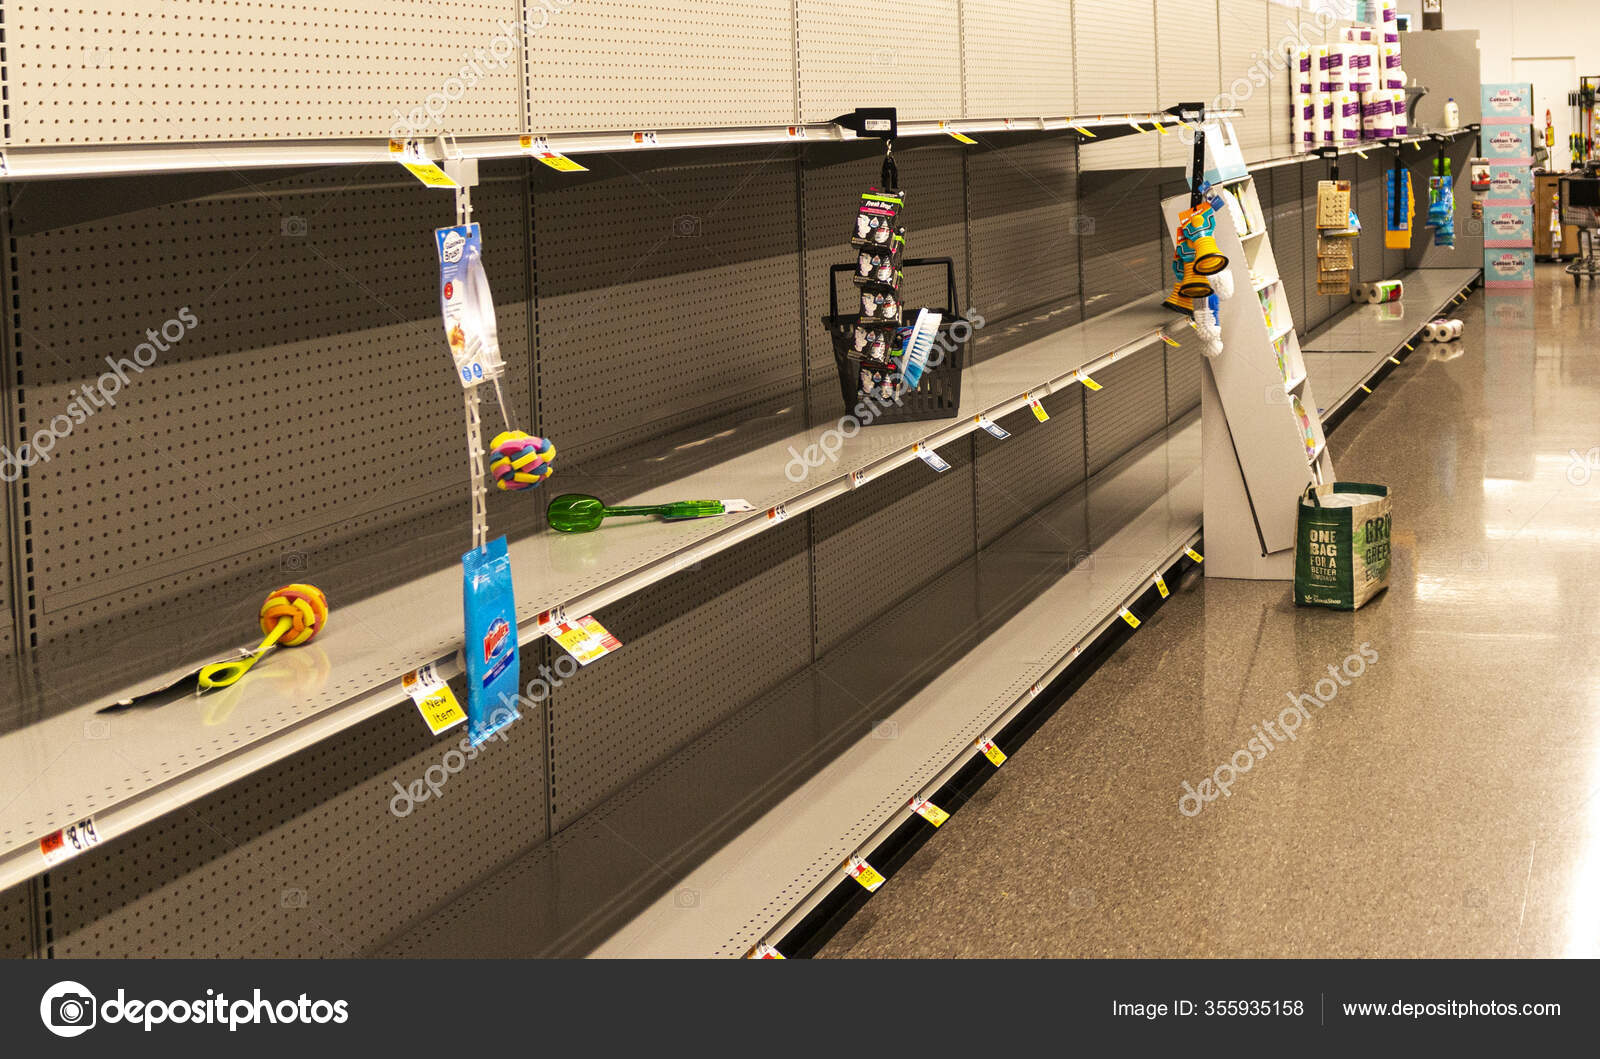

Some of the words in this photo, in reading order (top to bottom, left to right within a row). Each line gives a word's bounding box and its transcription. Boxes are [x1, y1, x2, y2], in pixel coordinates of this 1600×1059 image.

[1310, 529, 1336, 543] ONE
[1310, 542, 1337, 557] BAG
[1310, 556, 1326, 567] FOR
[1329, 557, 1337, 568] A
[1311, 567, 1337, 576] BETTER
[426, 695, 447, 710] New
[433, 708, 456, 724] Item
